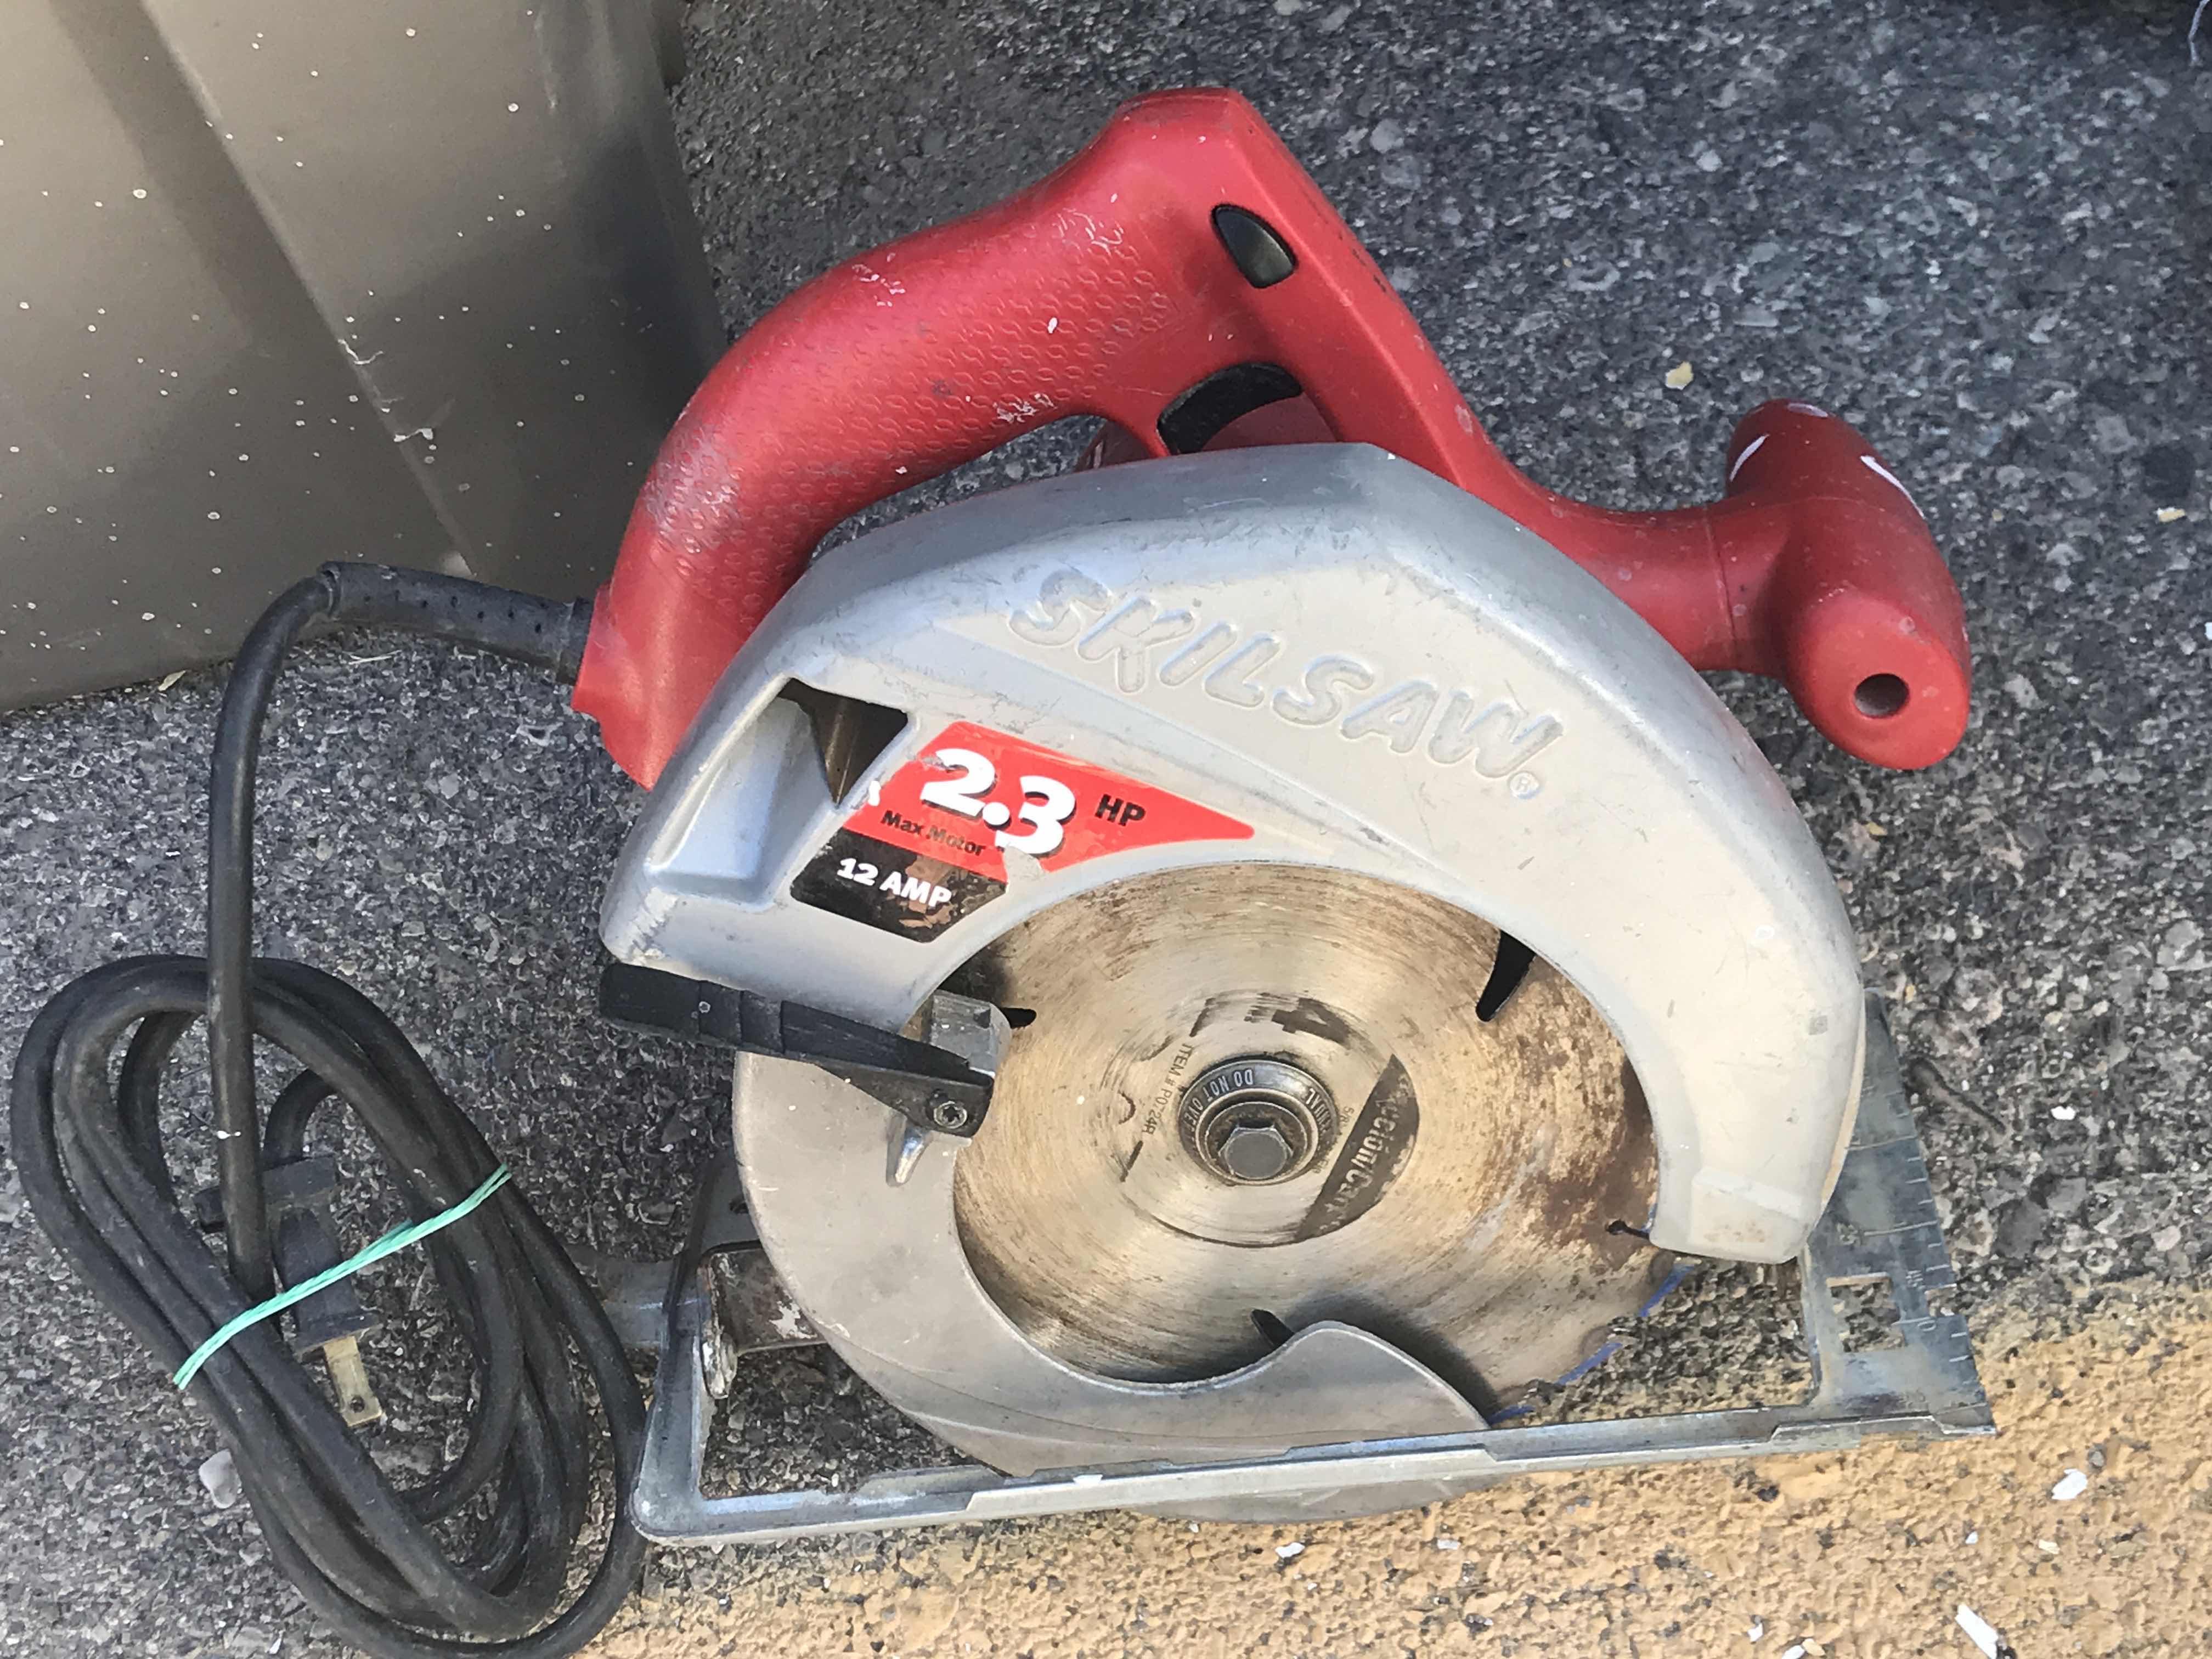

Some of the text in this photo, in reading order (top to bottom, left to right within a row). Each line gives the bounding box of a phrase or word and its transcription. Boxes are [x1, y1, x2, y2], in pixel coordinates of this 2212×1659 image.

[920, 748, 1146, 859] 2.3 HP
[880, 810, 986, 856] Max Motor
[837, 857, 952, 907] 12 AMP
[1167, 1042, 1195, 1077] ITEM
[1233, 1067, 1254, 1087] DO
[1202, 1075, 1229, 1102] NOT
